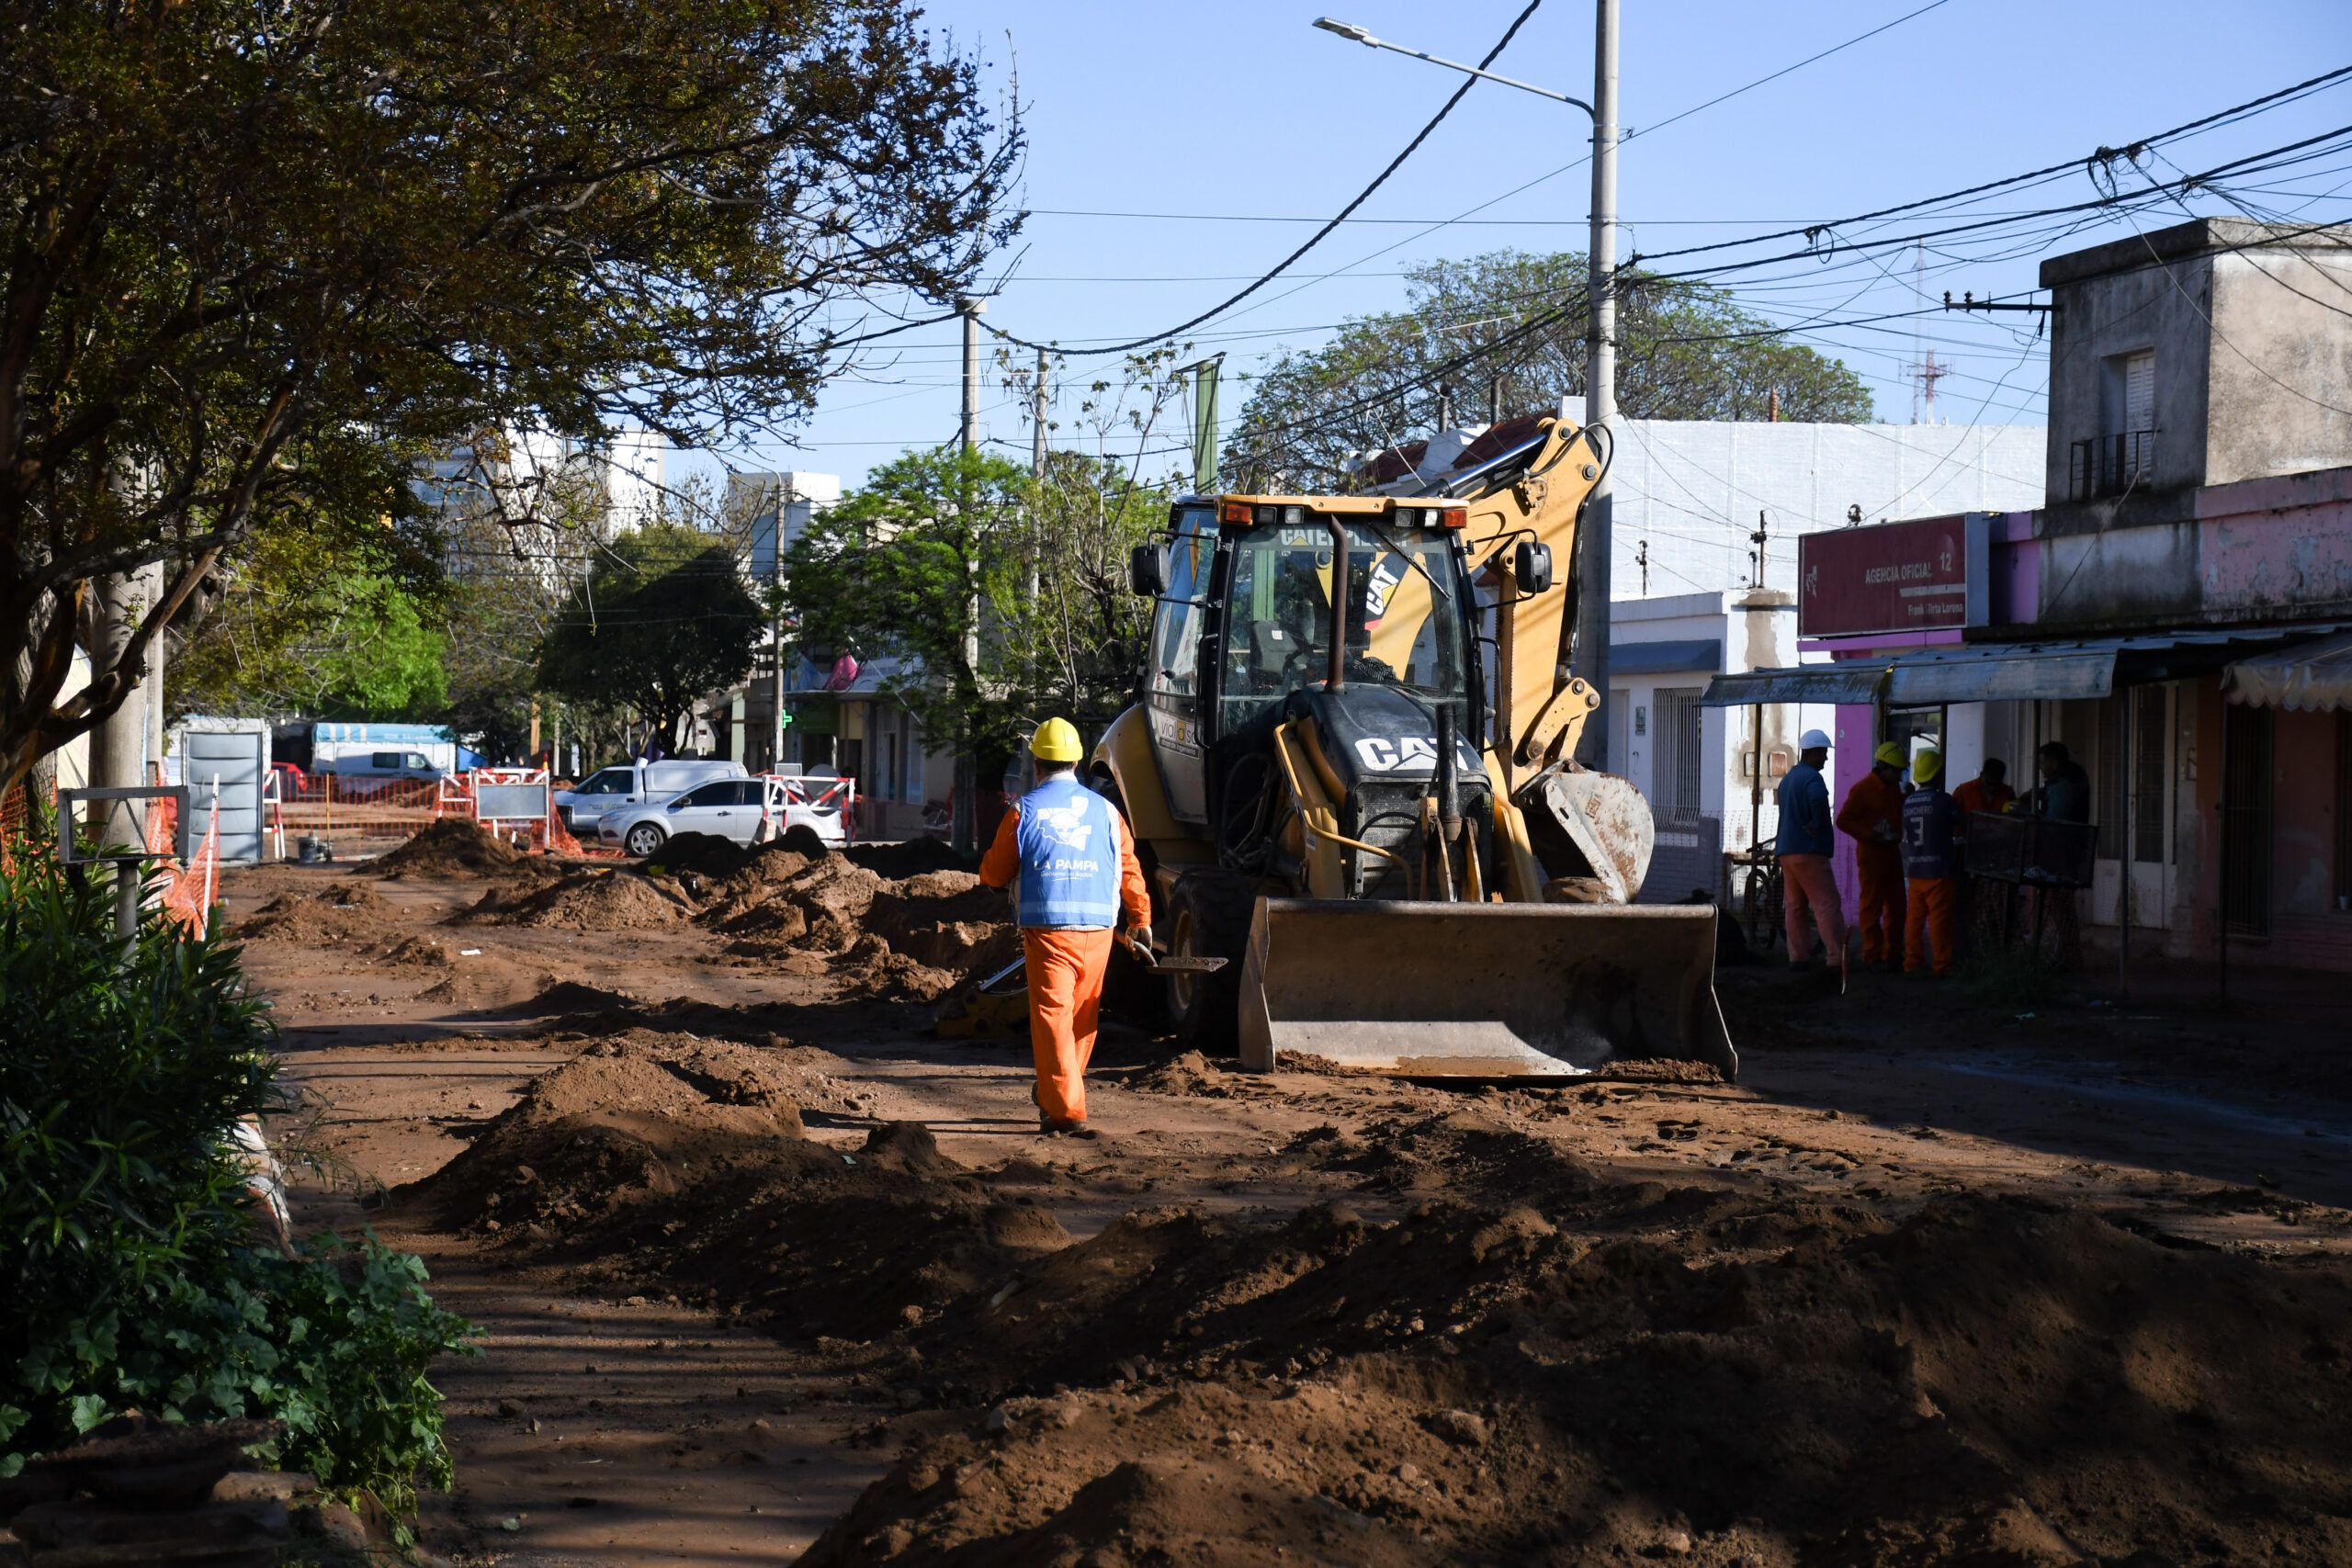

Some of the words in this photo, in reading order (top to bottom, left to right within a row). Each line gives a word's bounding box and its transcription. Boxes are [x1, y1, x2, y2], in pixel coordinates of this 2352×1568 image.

[1282, 527, 1408, 547] CATEPIL
[1939, 552, 1952, 571] 12
[1865, 565, 1899, 584] AGENCIA
[1901, 562, 1933, 580] OFICIAL
[1365, 563, 1399, 615] CAT
[1910, 817, 1924, 846] 3
[1034, 860, 1051, 871] LA
[1055, 859, 1099, 873] PAMPA
